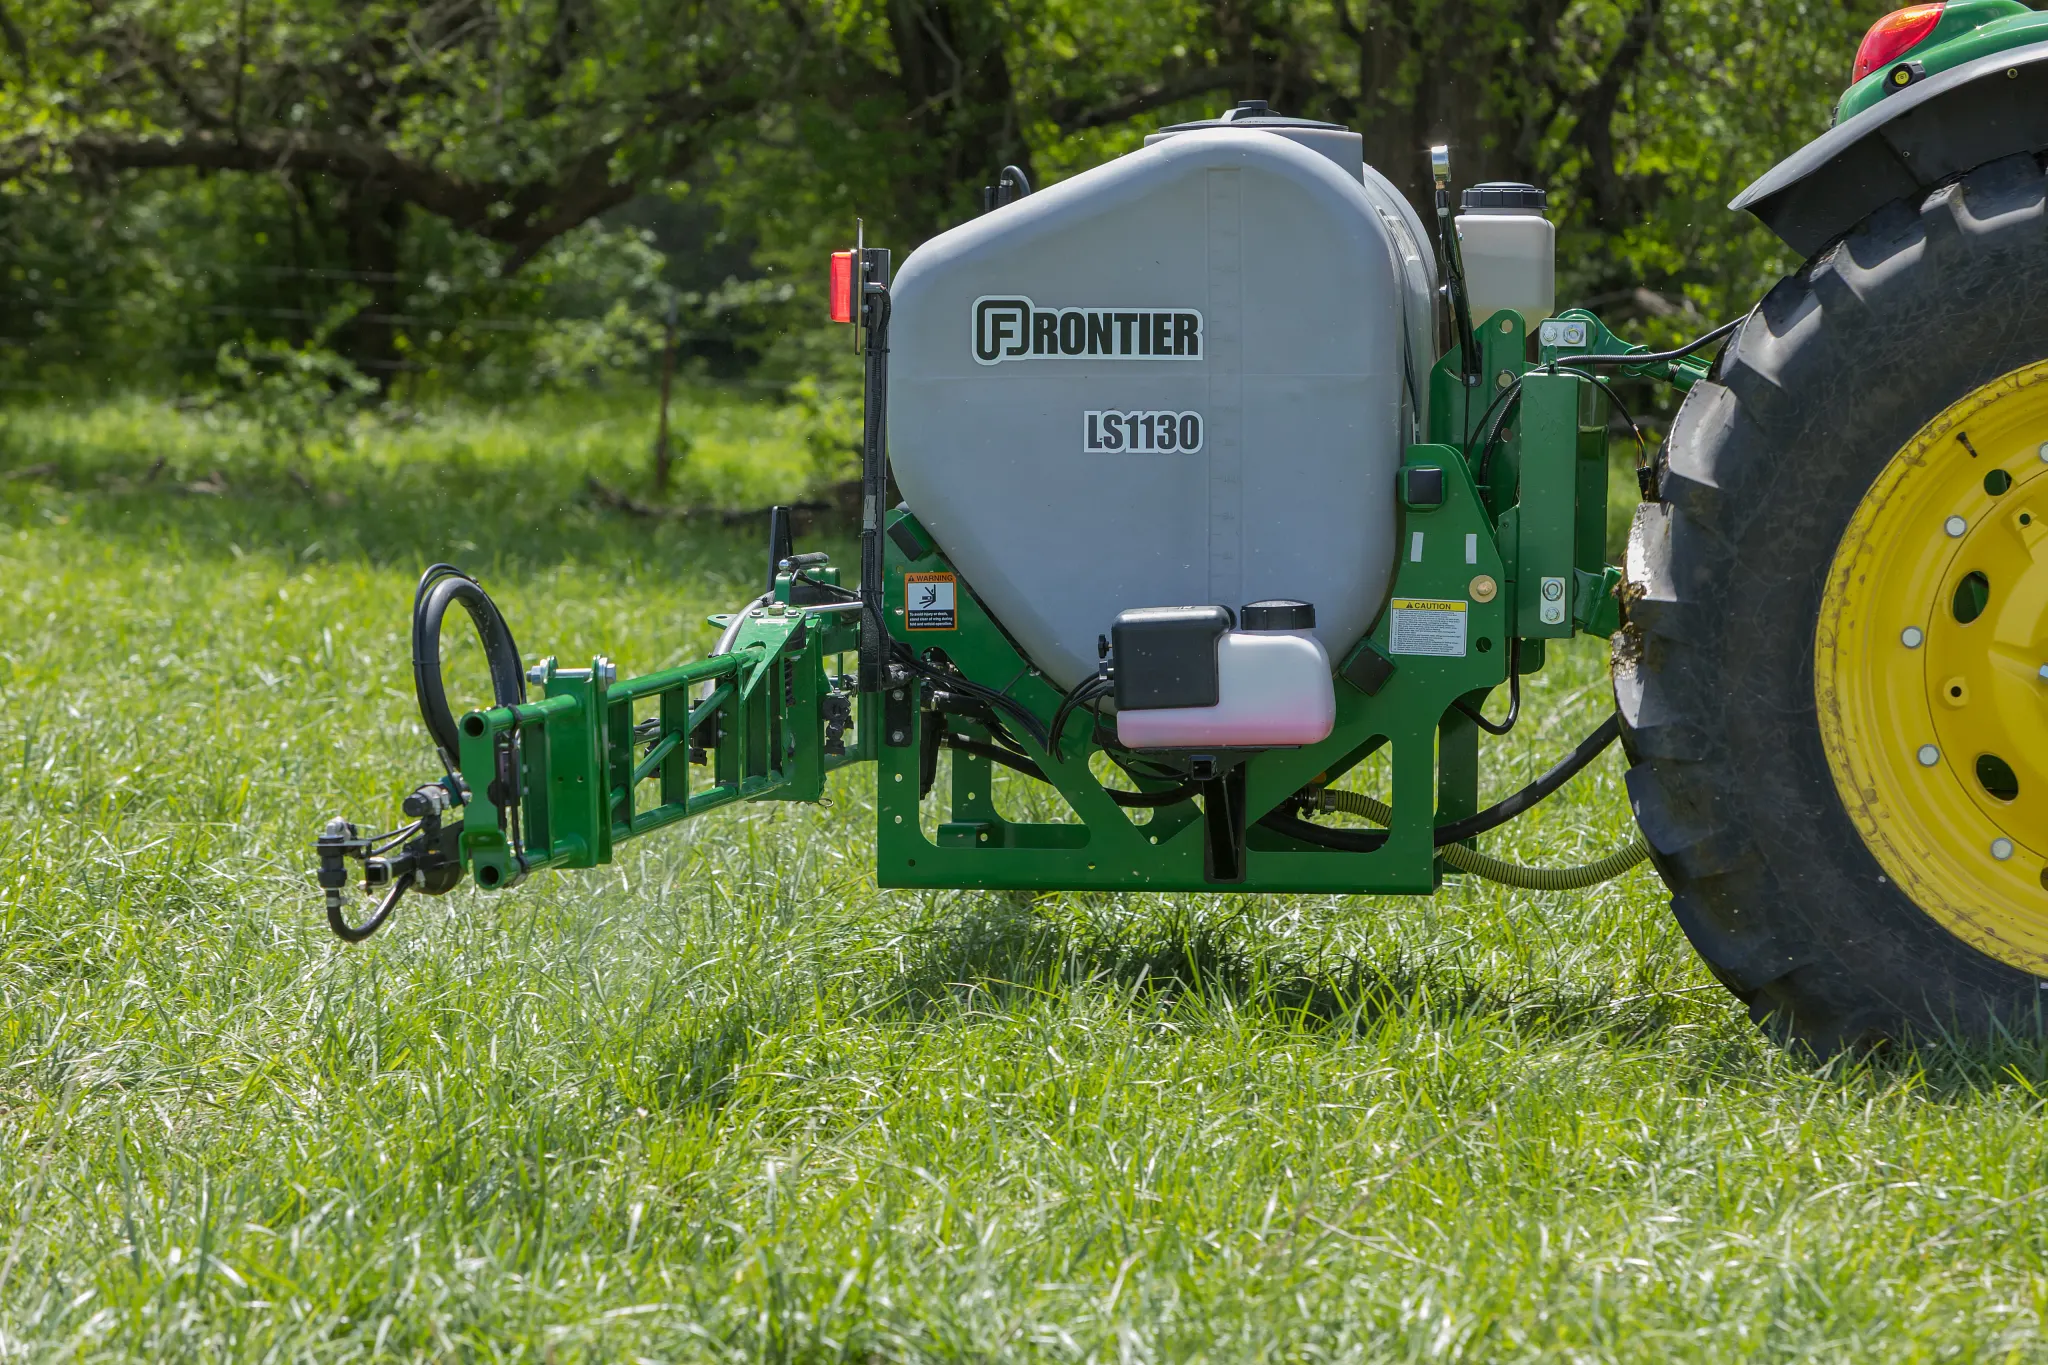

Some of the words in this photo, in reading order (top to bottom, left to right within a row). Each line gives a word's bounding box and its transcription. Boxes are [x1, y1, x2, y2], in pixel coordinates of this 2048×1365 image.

[976, 299, 1199, 361] FRONTIER
[1087, 414, 1200, 450] LS1130
[1414, 602, 1452, 610] CAUTION
